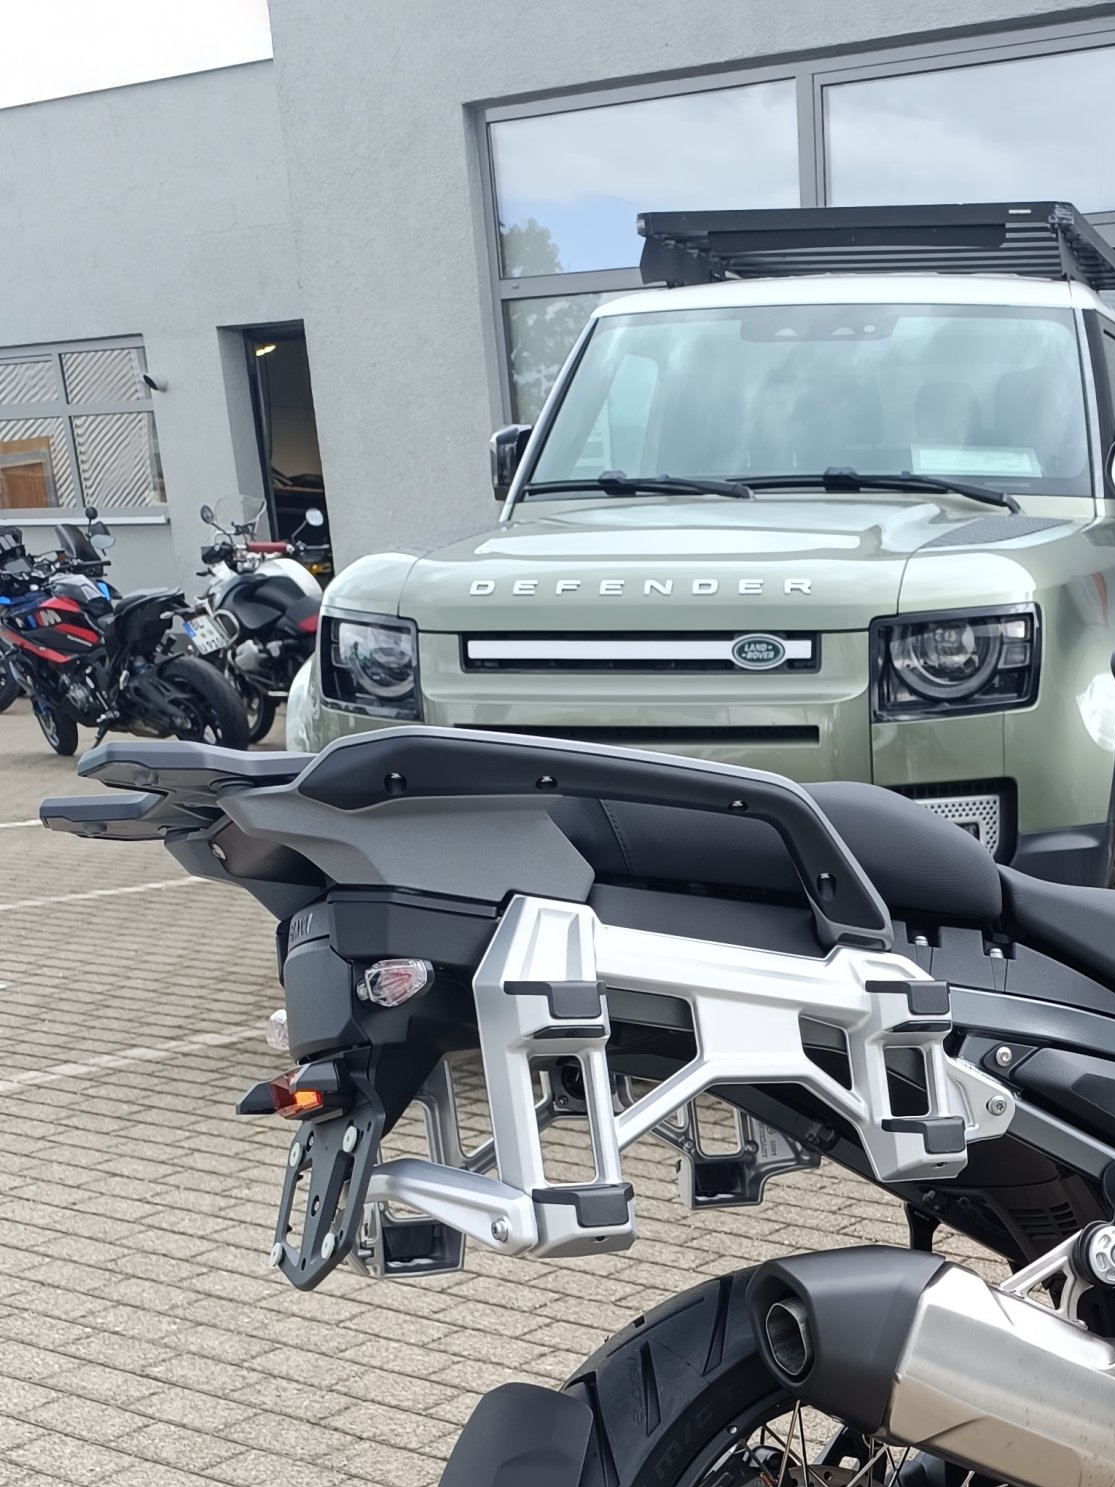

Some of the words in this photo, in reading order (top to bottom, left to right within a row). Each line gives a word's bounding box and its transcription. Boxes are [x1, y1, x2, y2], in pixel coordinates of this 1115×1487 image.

[469, 578, 813, 596] DEFENDER
[744, 643, 768, 652] LAND
[746, 650, 775, 660] ROVER
[654, 1402, 714, 1482] M/C
